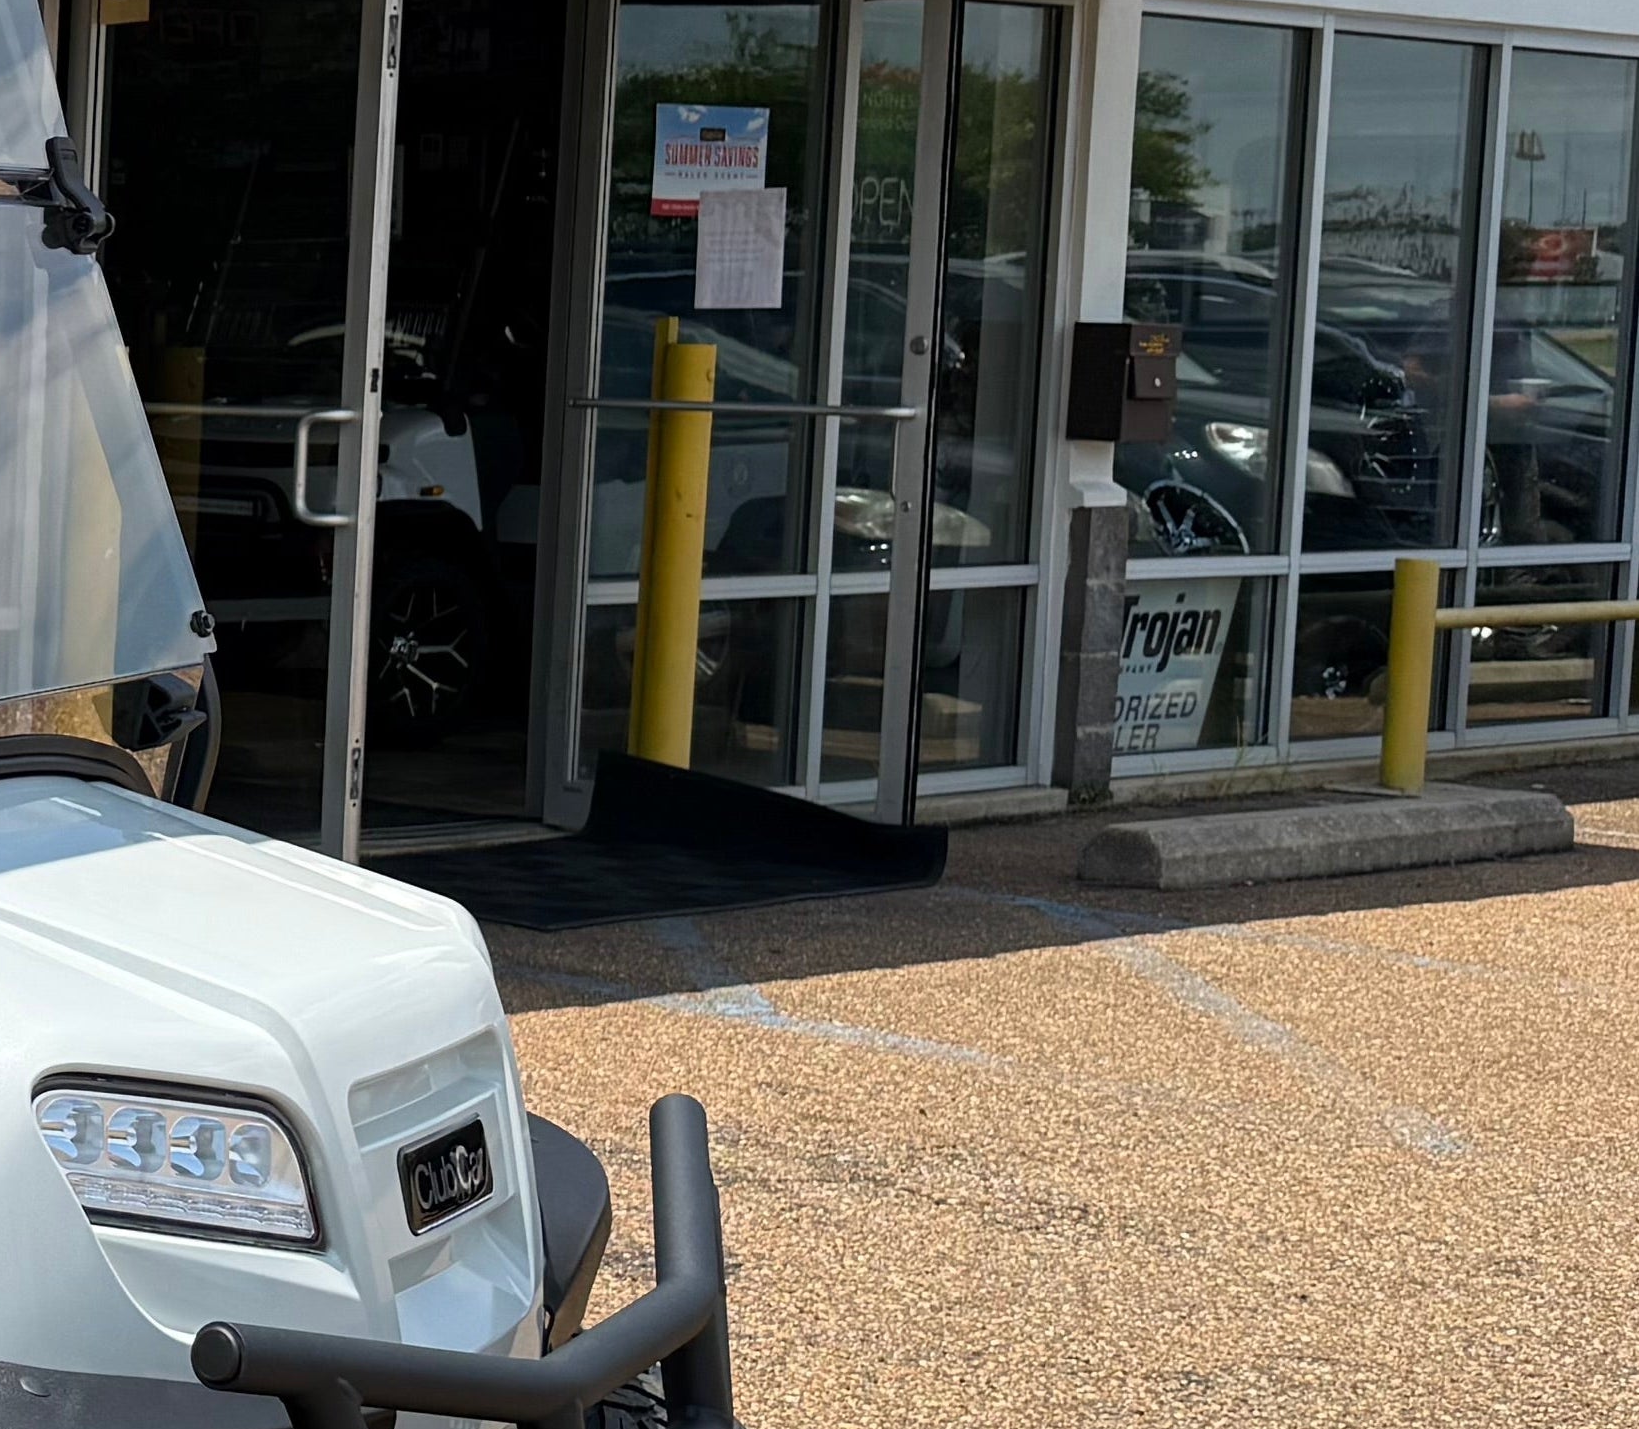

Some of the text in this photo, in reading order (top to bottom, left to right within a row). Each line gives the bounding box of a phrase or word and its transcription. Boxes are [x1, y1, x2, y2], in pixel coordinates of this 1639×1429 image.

[665, 142, 760, 169] SUMMER SAVINGS
[1122, 592, 1222, 672] Trojan
[1113, 691, 1198, 723] ORIZED
[1112, 724, 1160, 752] LER
[413, 1156, 459, 1210] Club
